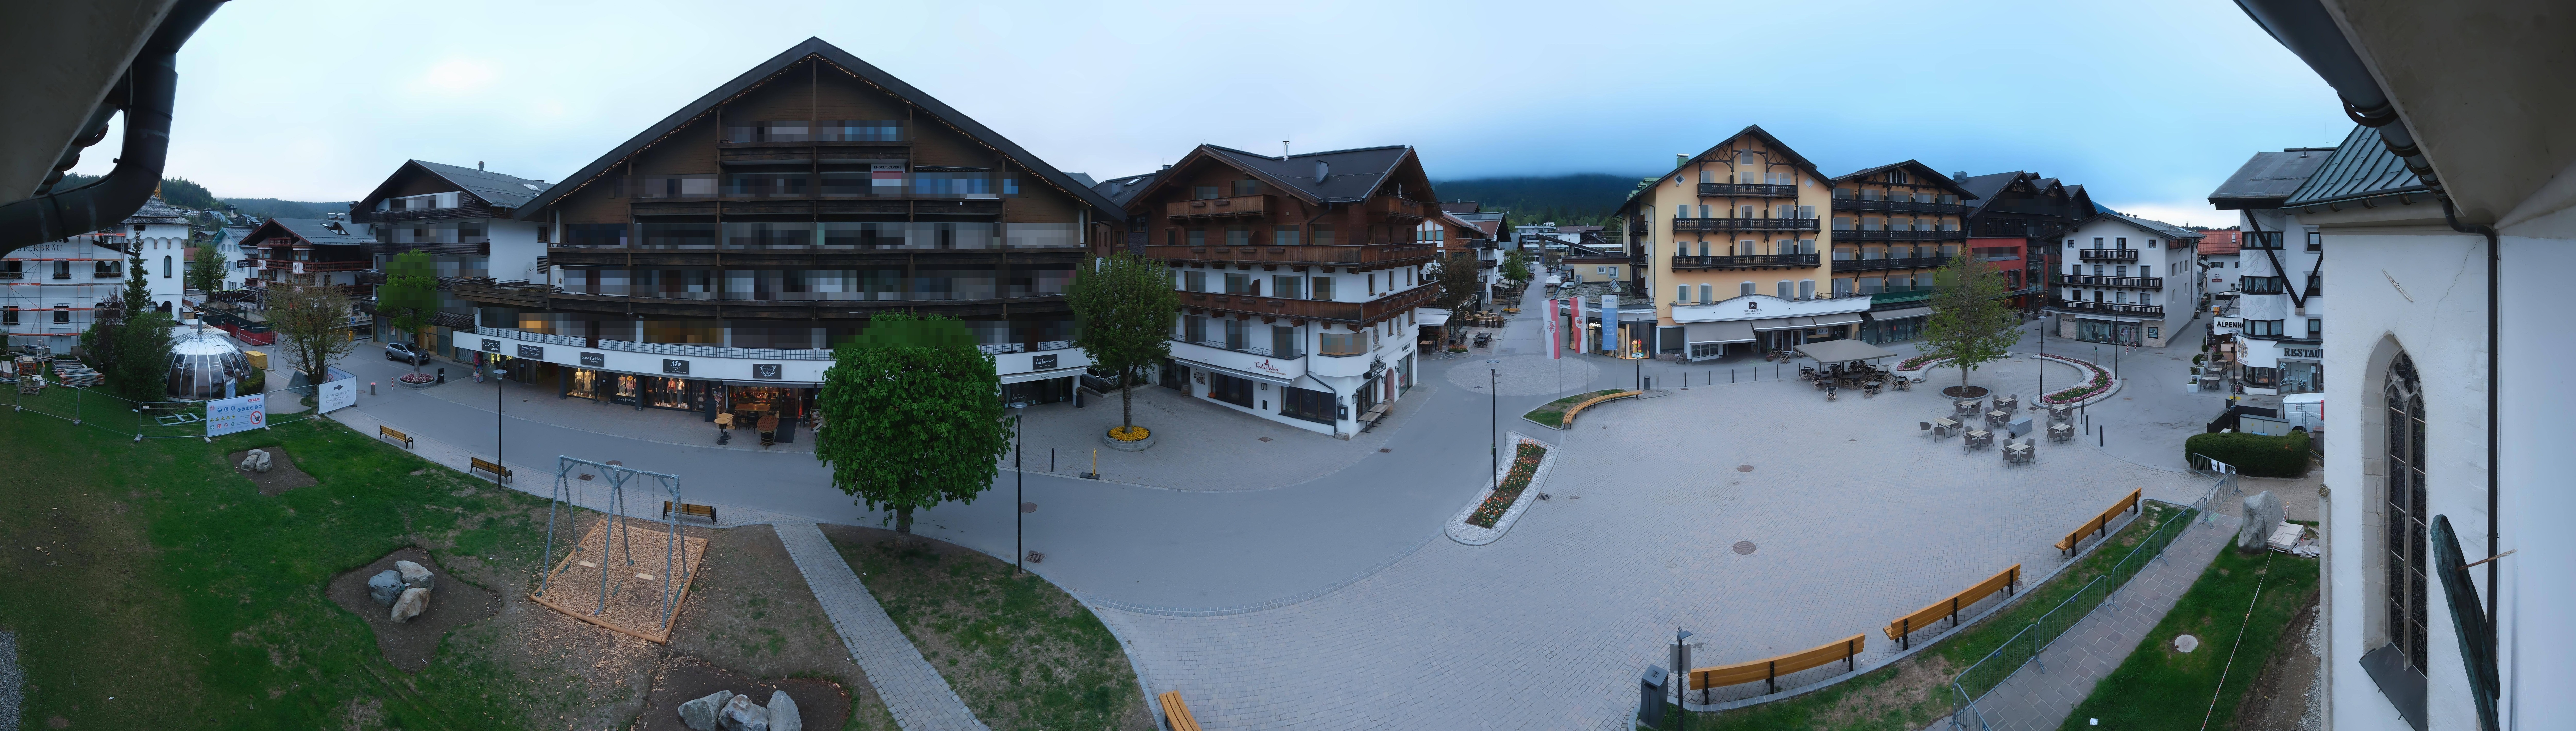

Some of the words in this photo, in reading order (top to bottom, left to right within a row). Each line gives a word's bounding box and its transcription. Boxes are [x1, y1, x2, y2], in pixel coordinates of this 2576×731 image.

[1402, 343, 1410, 352] SAILER
[1371, 364, 1385, 377] RESTAURANT
[326, 394, 350, 403] KONGRESSZENTRUM
